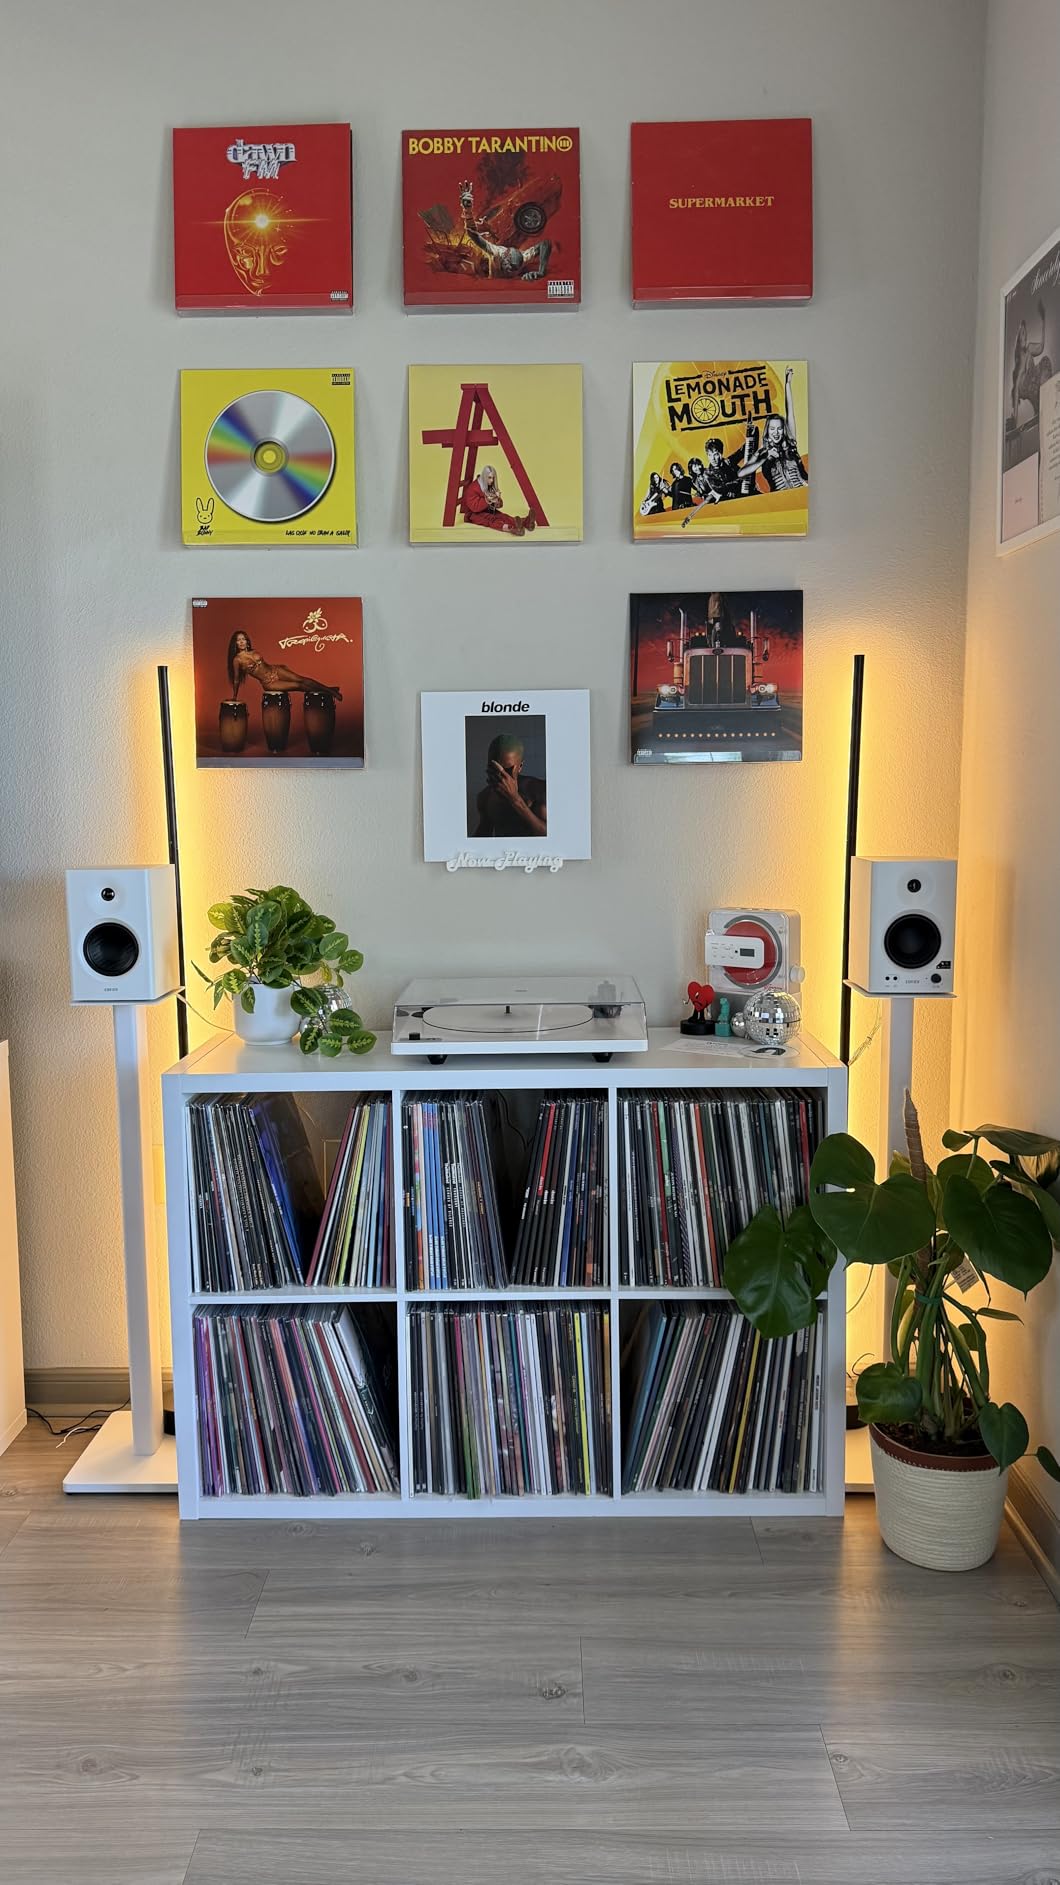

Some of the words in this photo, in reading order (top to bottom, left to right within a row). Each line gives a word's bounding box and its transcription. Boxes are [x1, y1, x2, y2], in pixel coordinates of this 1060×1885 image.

[408, 137, 465, 155] BOBBY
[668, 196, 775, 209] SUPERMARKET
[665, 372, 769, 403] LEMONADE
[668, 389, 773, 432] MOUTH
[481, 700, 530, 713] blonde
[446, 850, 495, 873] Now
[494, 850, 564, 874] Playing
